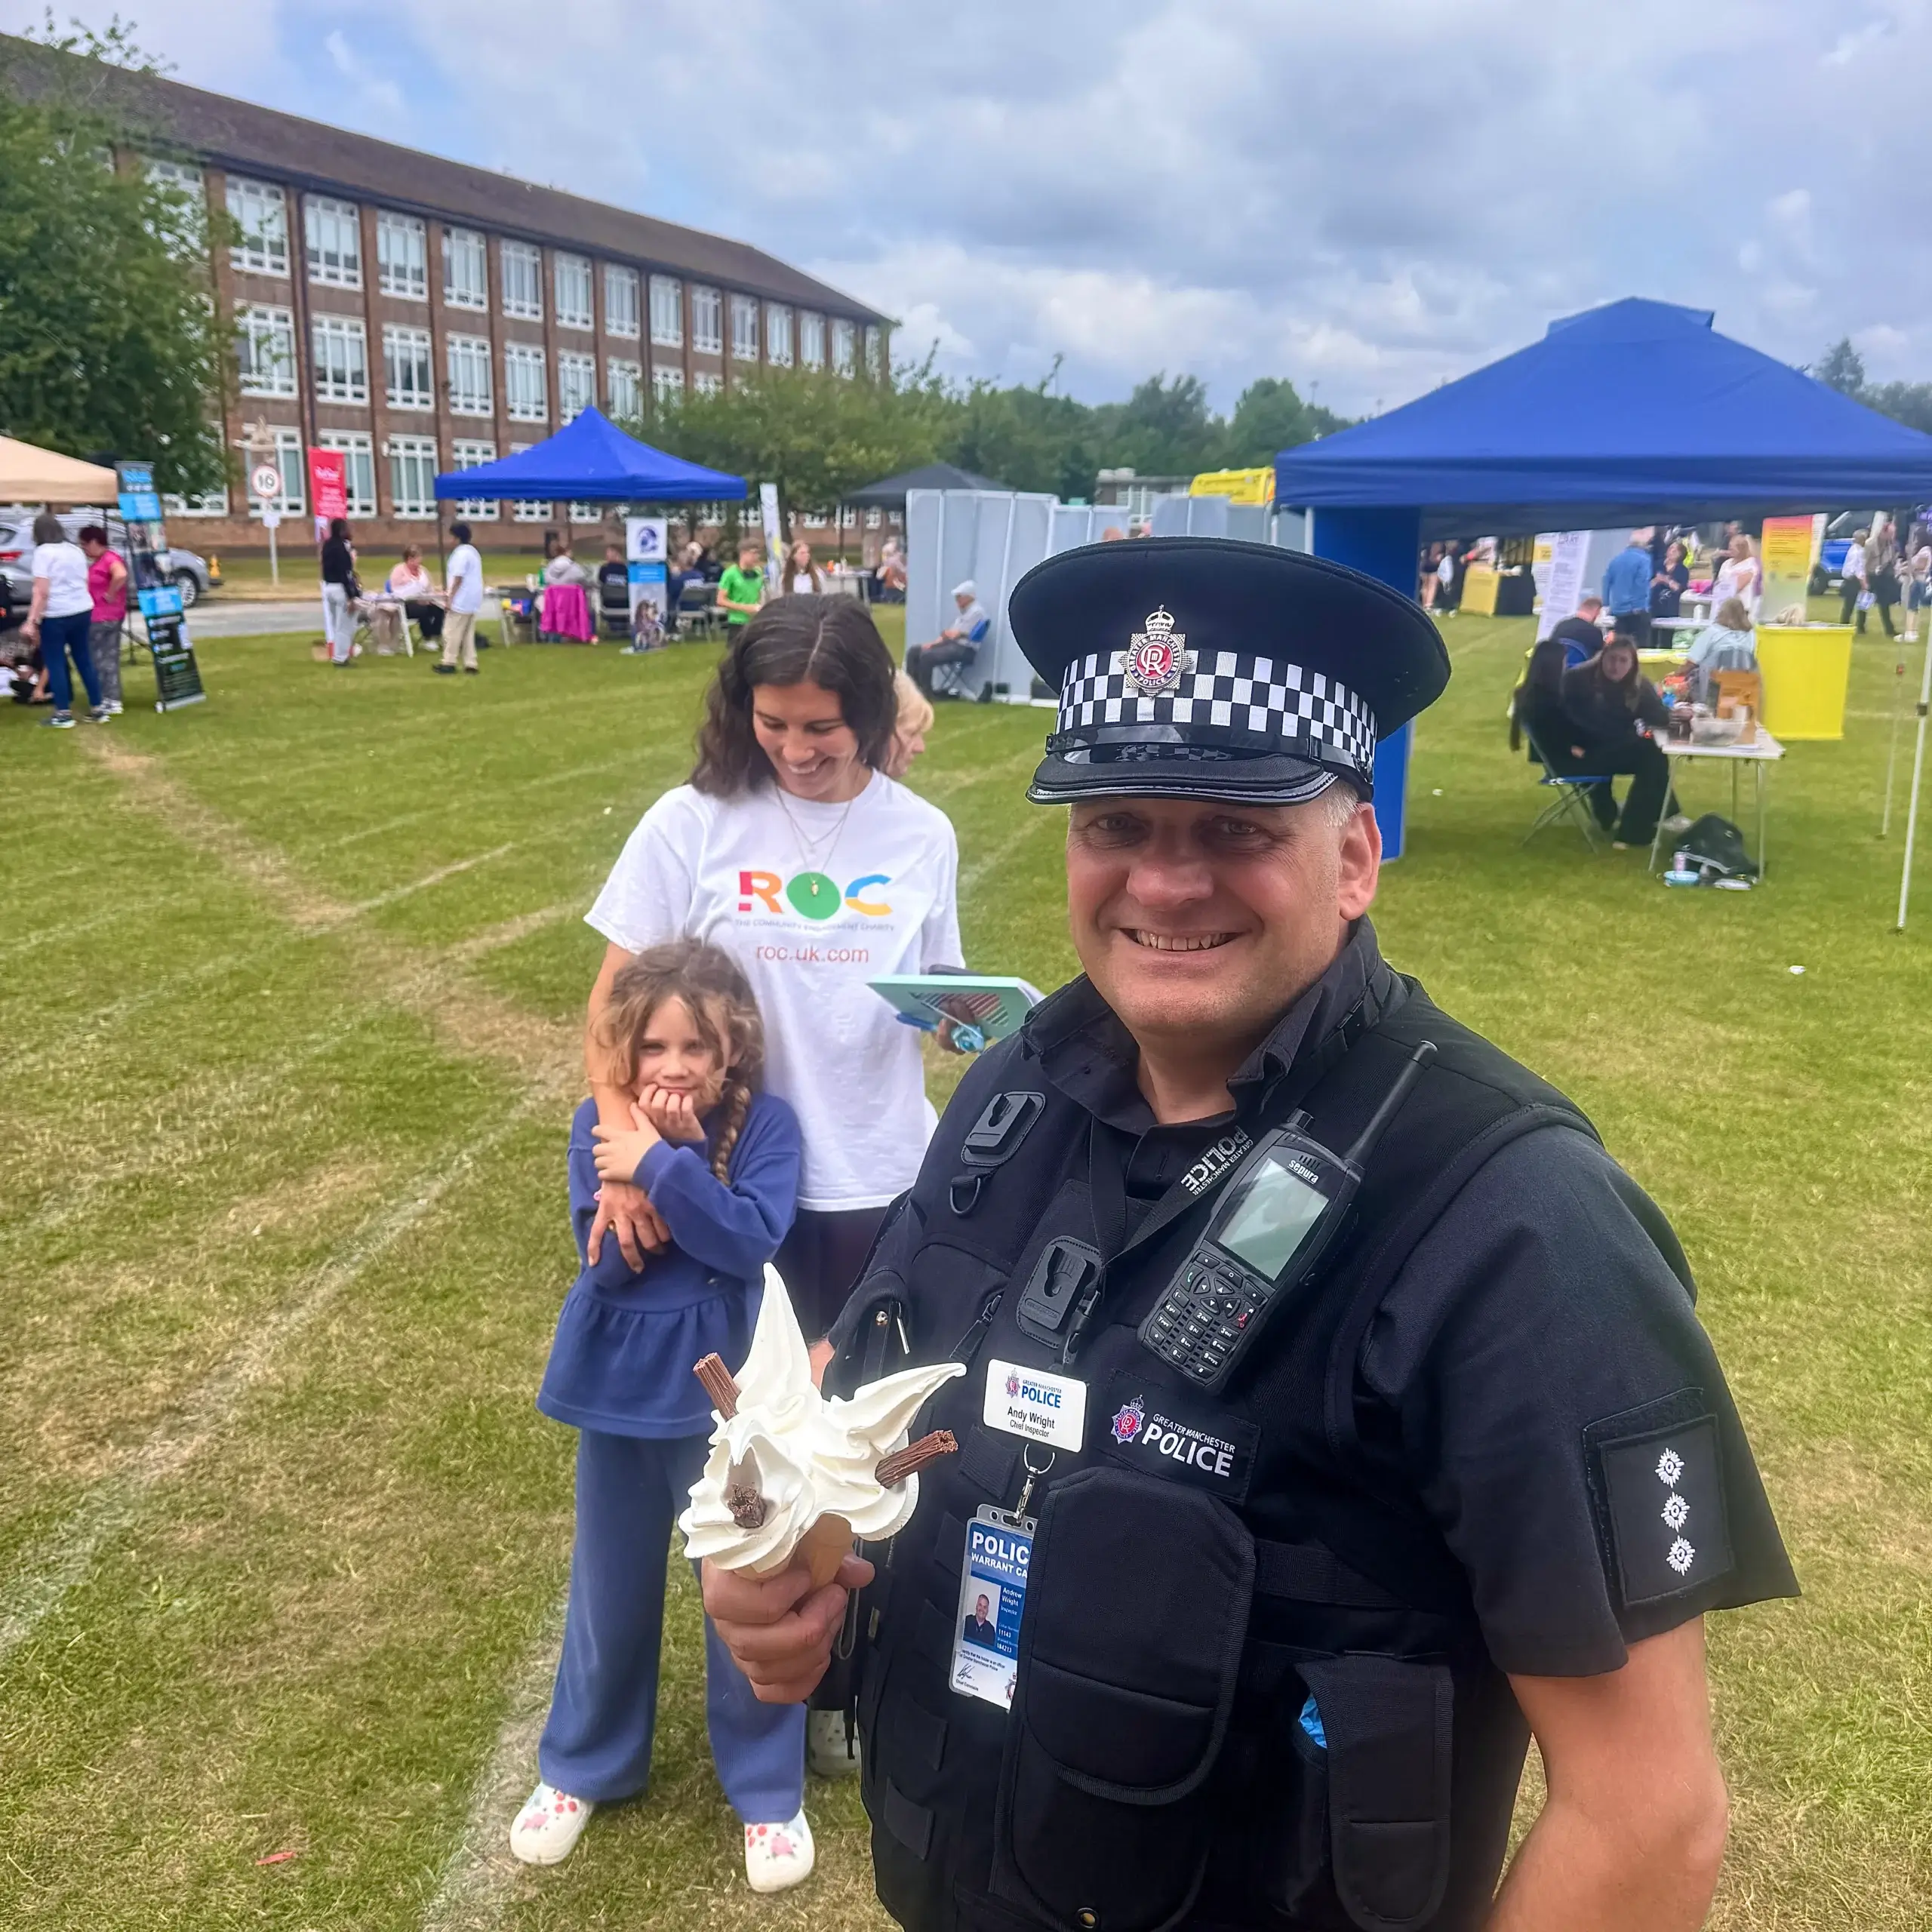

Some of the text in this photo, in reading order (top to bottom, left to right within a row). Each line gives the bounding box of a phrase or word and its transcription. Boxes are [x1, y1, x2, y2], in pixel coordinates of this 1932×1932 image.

[1130, 635, 1180, 672] GREATER MANCHESTER
[1138, 676, 1165, 686] POLICE
[738, 871, 893, 920] ROC
[756, 944, 869, 964] roc.uk.com
[1180, 1125, 1249, 1192] POLICE
[1192, 1139, 1254, 1195] GREATER MANCHESTER
[1287, 1160, 1319, 1184] sepura
[1022, 1386, 1062, 1408] POLICE
[1008, 1406, 1055, 1429] Andy Wright
[1010, 1420, 1050, 1437] Chief Inspector
[1153, 1414, 1186, 1435] GREATER
[1186, 1429, 1235, 1454] MANCHESTER
[1141, 1422, 1234, 1477] POLICE
[972, 1531, 1029, 1564] POLIC
[971, 1552, 1028, 1578] WARRANT CA
[1001, 1595, 1019, 1607] Wright
[1002, 1587, 1022, 1599] Andrew
